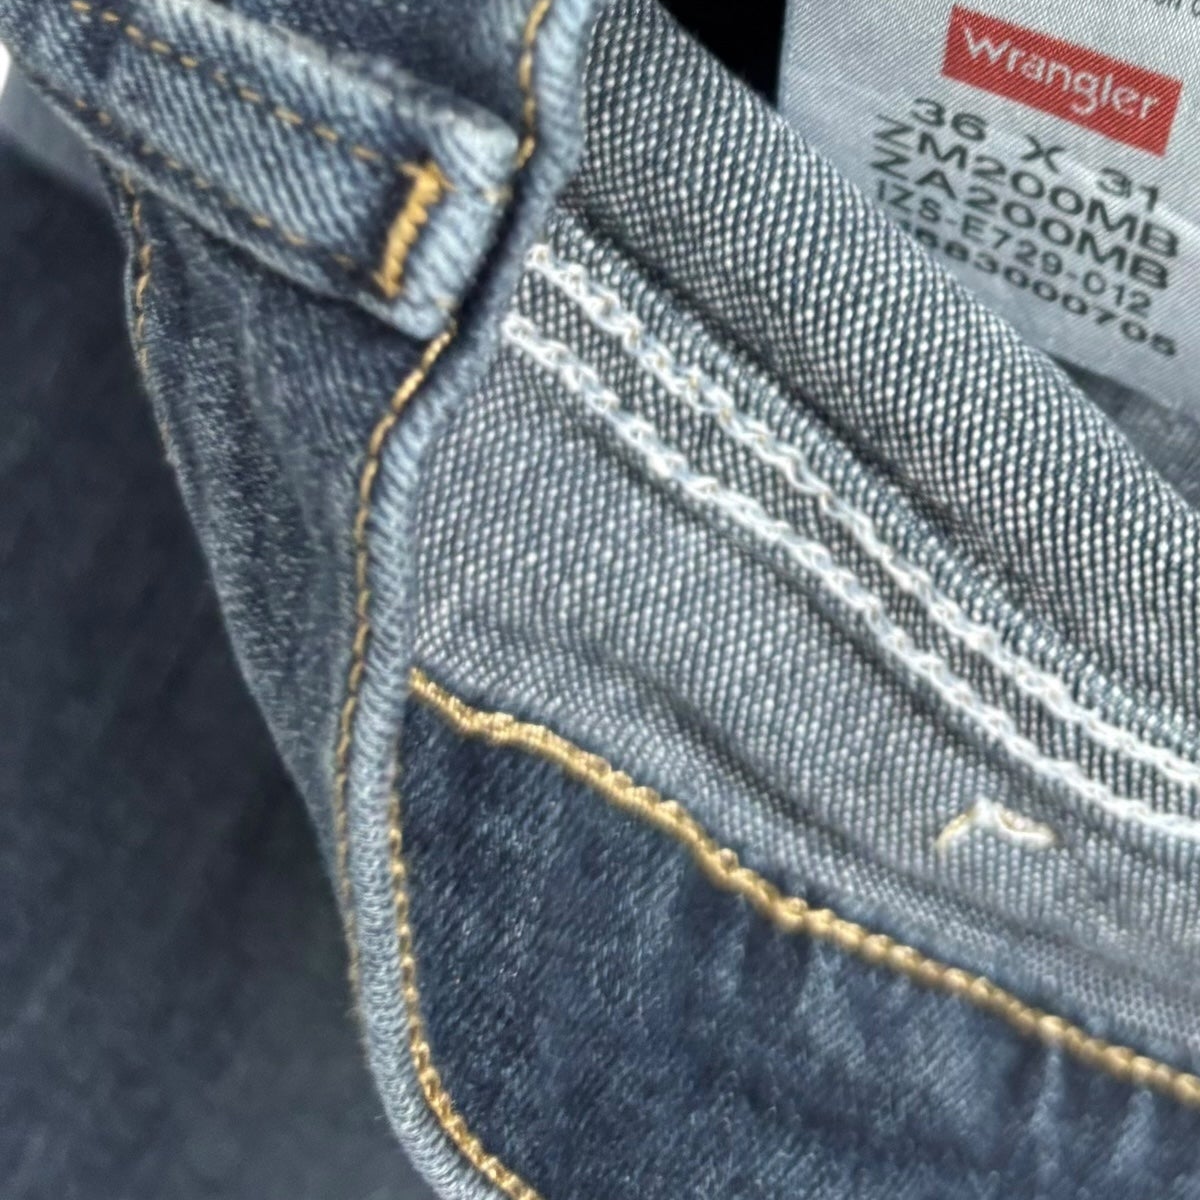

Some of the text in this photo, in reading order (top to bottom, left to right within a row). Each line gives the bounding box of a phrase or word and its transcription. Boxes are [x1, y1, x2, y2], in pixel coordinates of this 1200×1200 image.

[963, 26, 1161, 122] Wrangler
[869, 145, 1171, 290] ZA200MB
[872, 112, 1180, 258] ZM200MB
[910, 98, 1161, 213] 36 X 31
